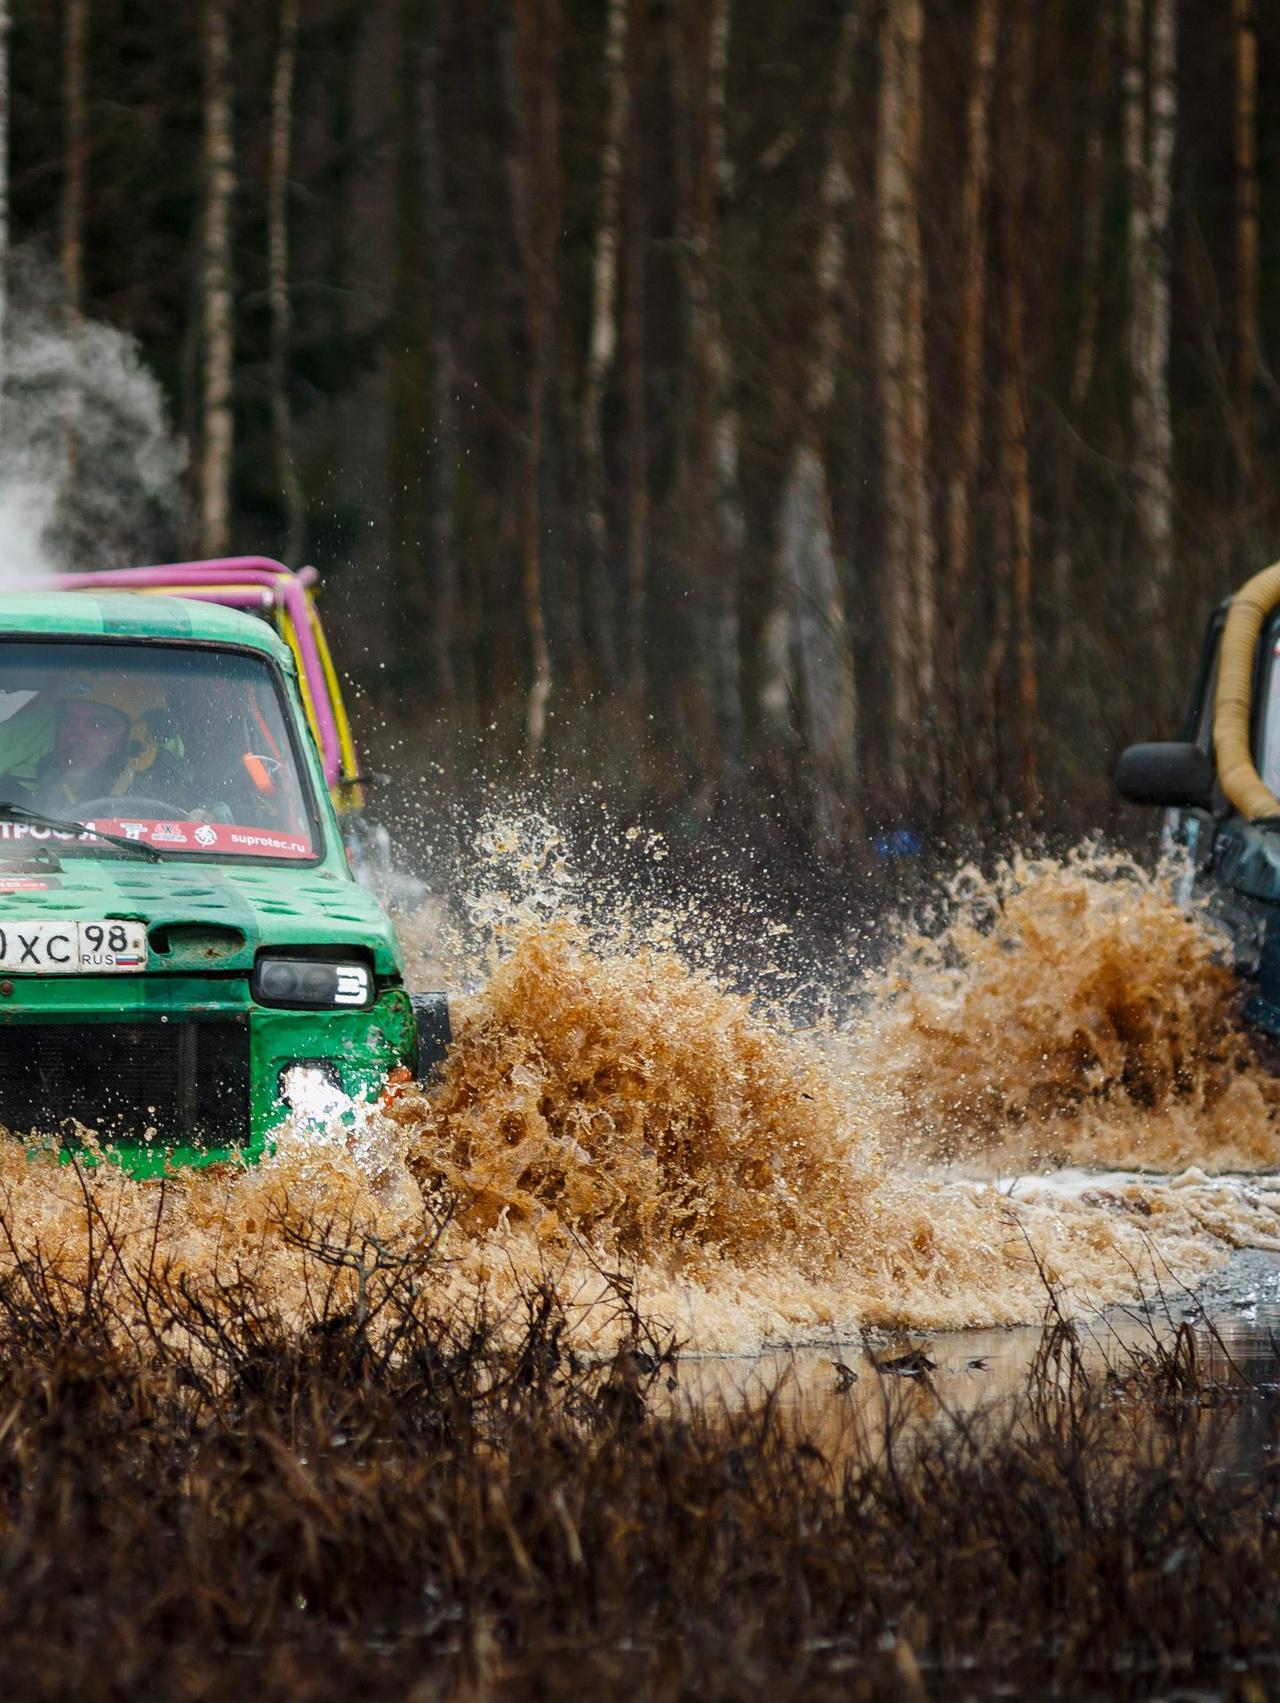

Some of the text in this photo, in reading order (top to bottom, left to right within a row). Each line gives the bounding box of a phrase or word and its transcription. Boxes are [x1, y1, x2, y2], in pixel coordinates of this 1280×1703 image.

[230, 832, 306, 853] suprotec.ru
[85, 925, 128, 952] 98
[82, 954, 115, 966] RUS
